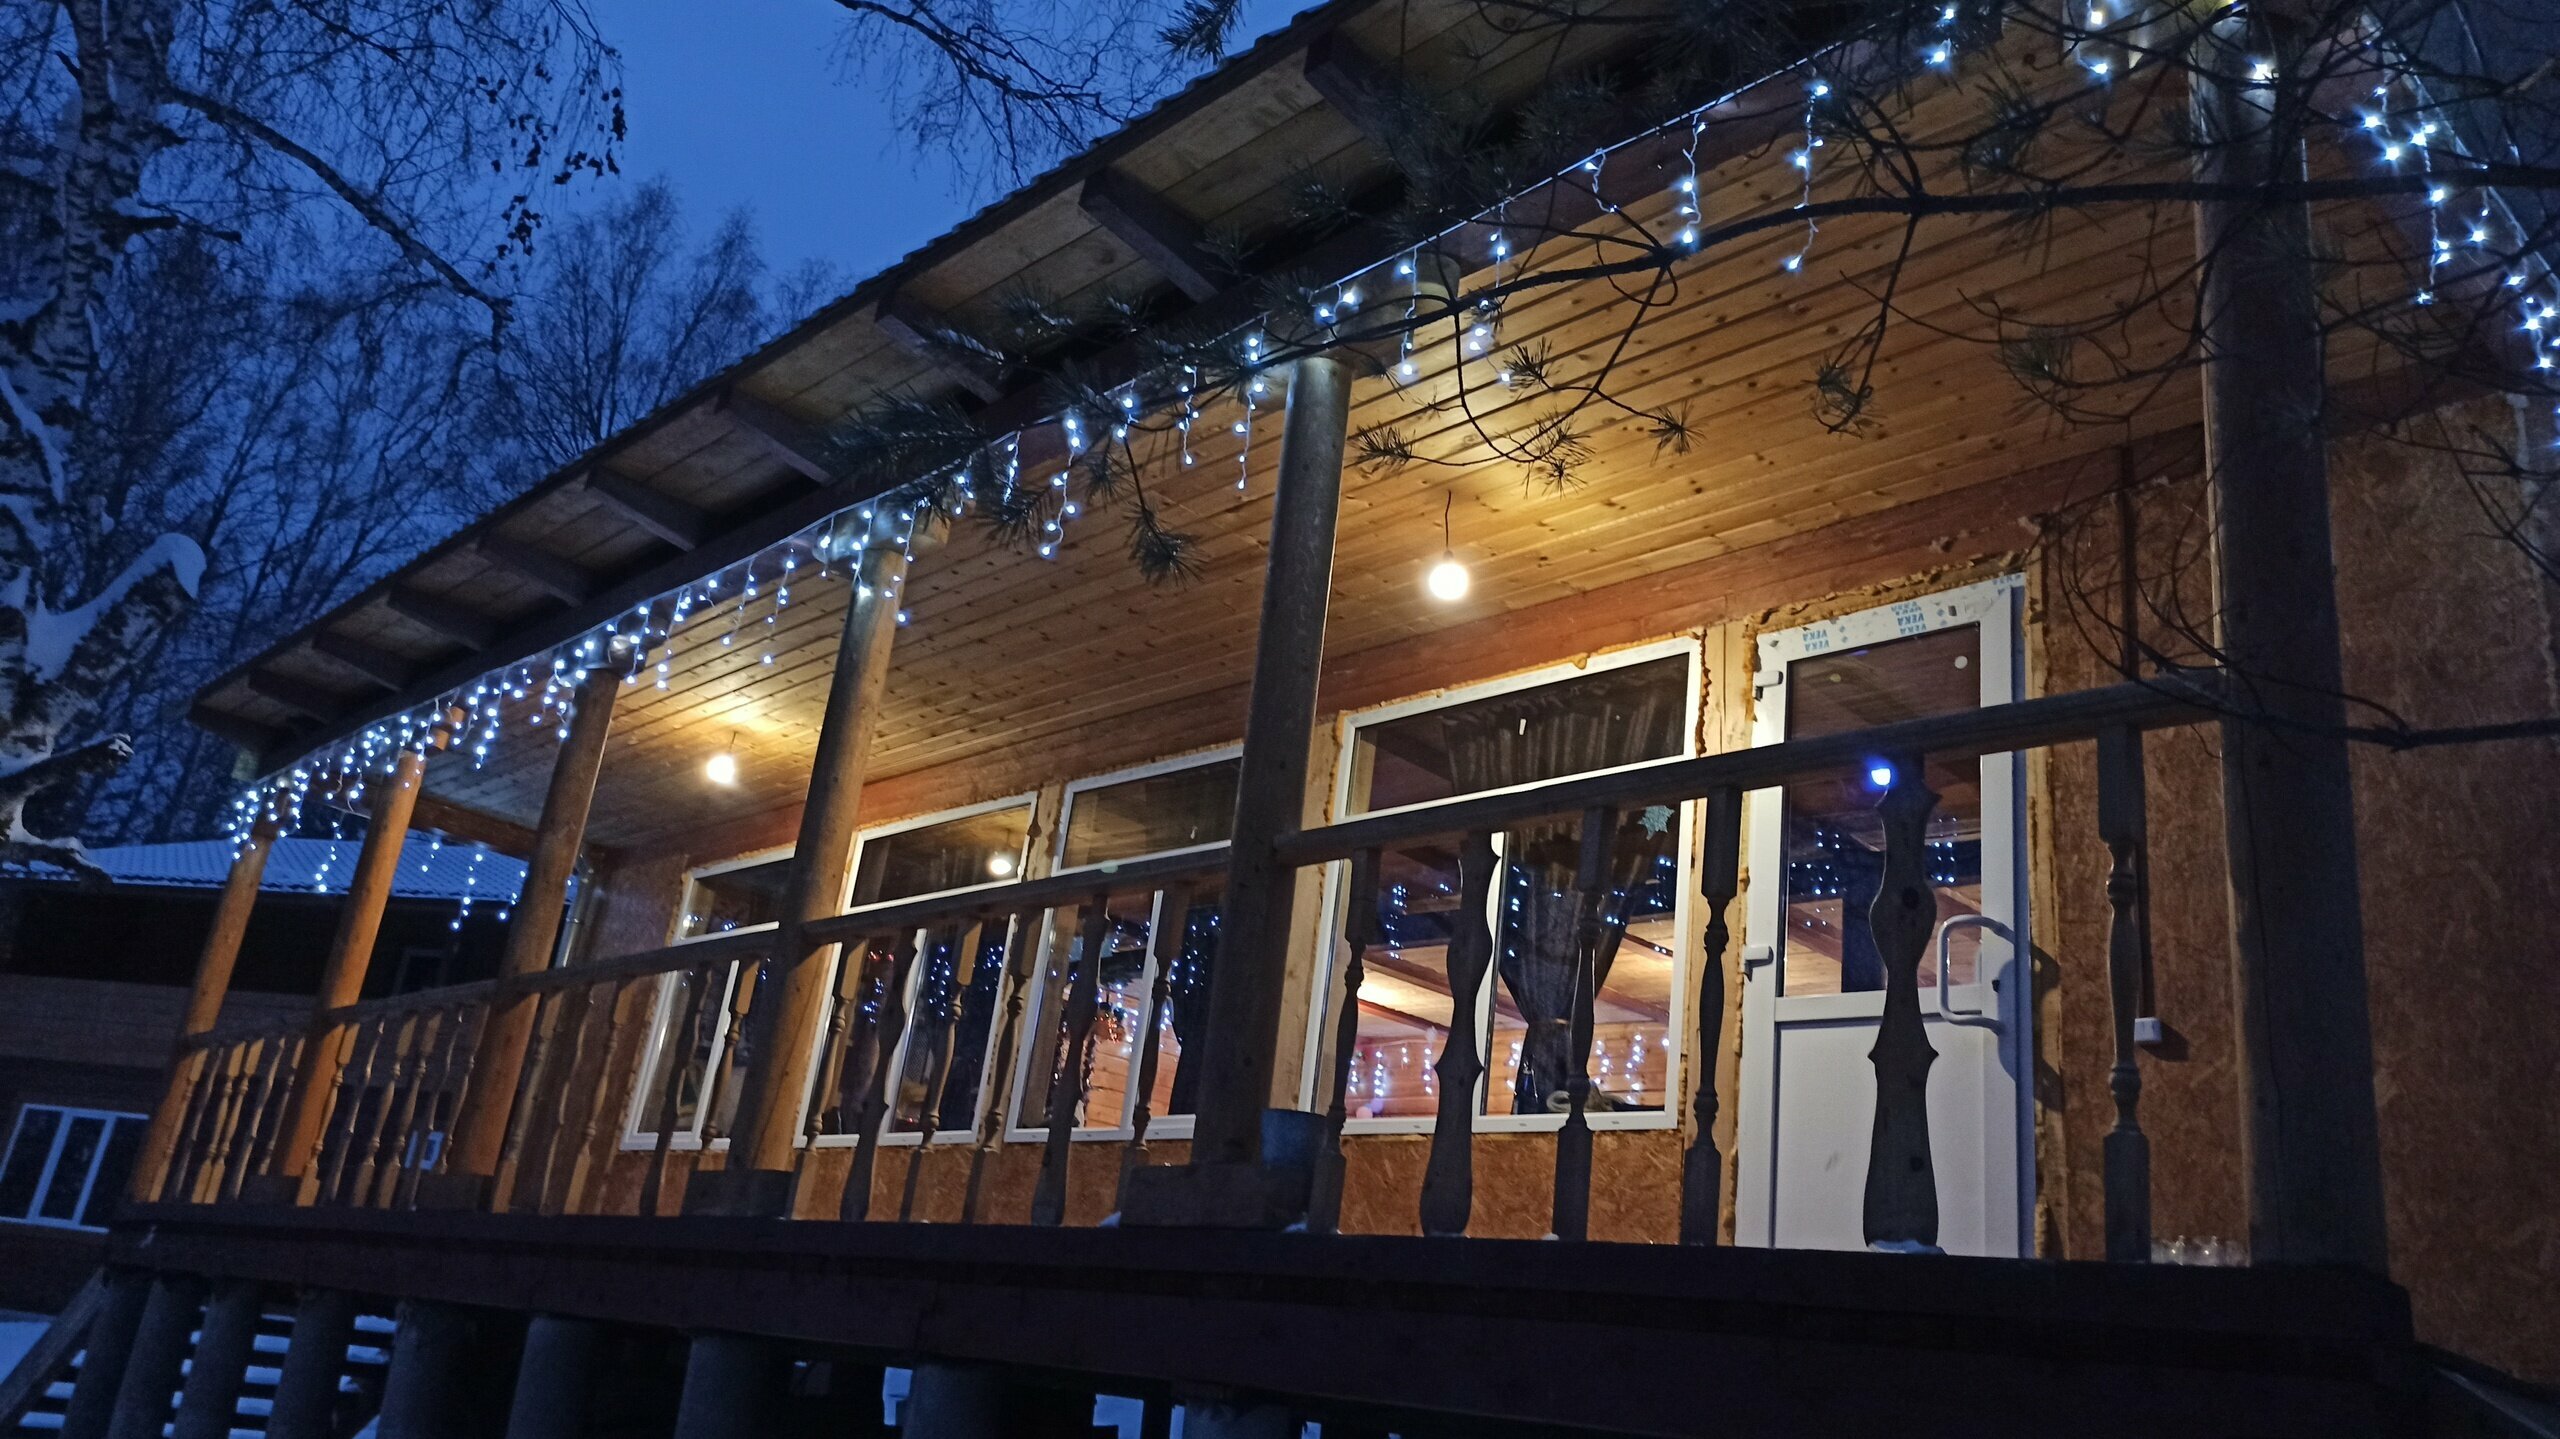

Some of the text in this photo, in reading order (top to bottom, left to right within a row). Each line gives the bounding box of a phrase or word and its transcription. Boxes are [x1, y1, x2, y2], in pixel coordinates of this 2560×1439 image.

[1897, 612, 1924, 626] VEKA
[1802, 629, 1827, 642] VEKA
[1900, 623, 1927, 635] VEKA
[1805, 639, 1829, 652] VEKA
